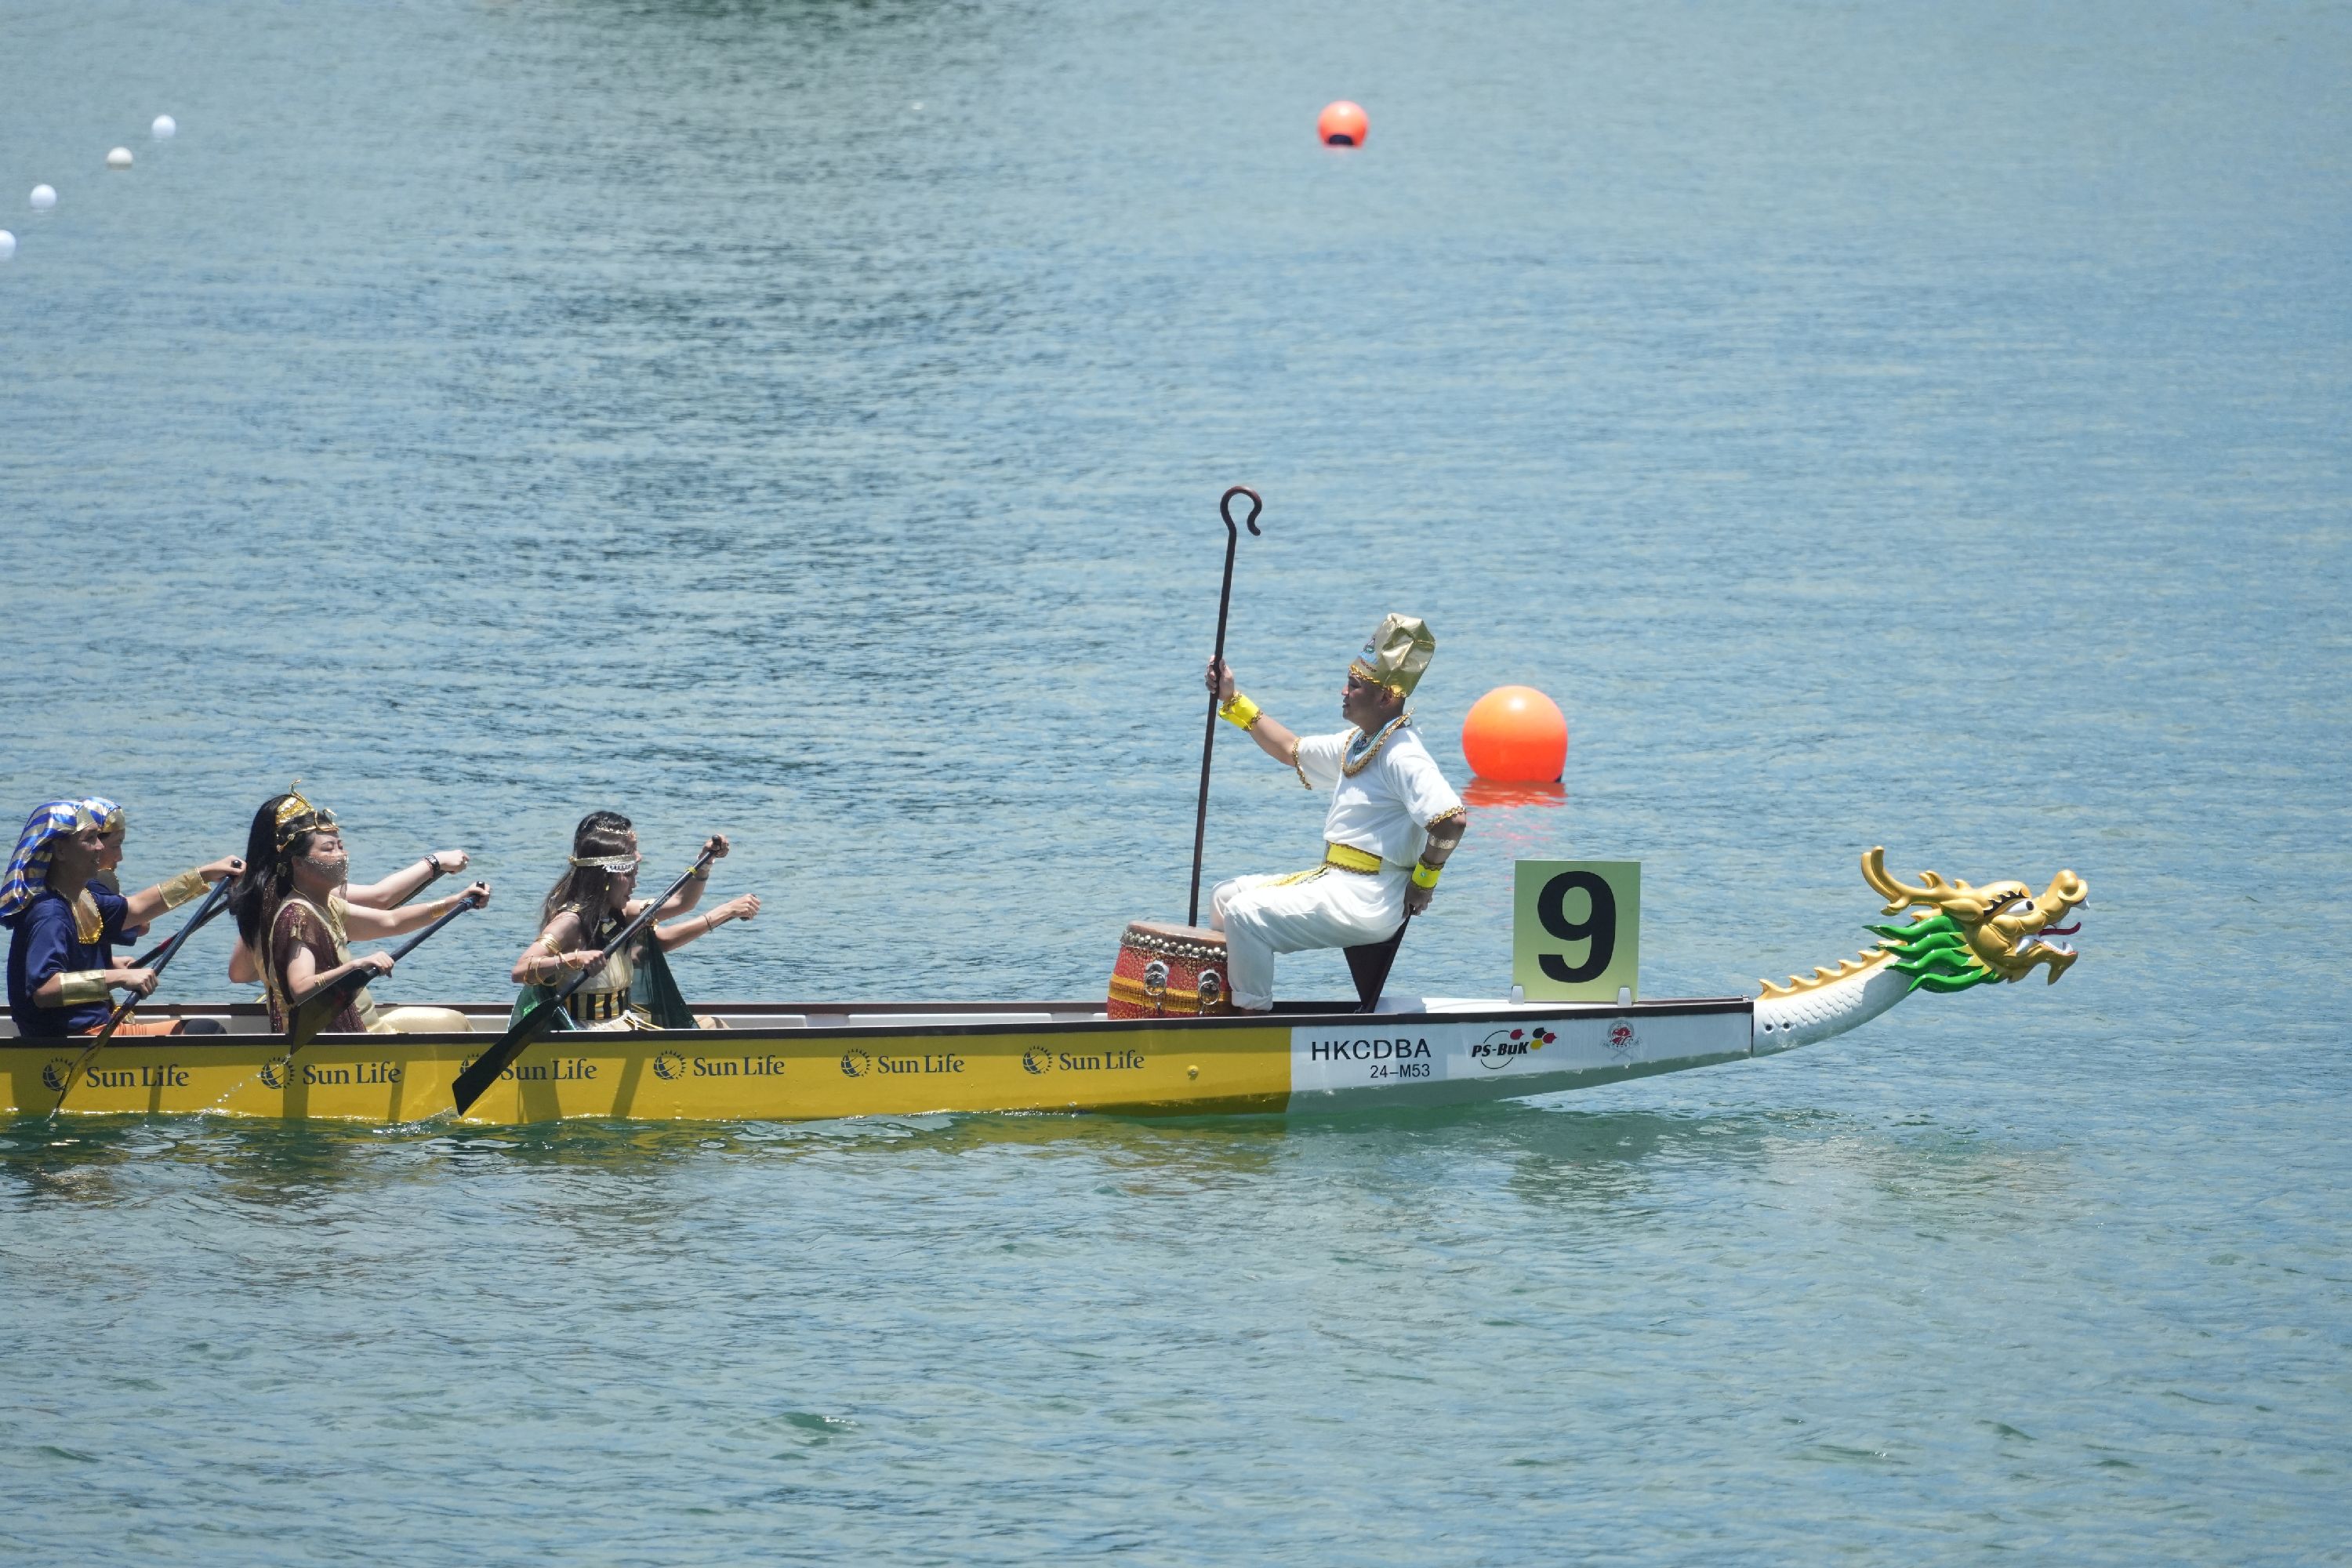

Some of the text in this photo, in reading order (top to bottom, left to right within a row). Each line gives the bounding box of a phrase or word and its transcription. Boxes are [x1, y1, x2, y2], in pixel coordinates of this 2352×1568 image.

[1537, 870, 1616, 983] 9
[1059, 1049, 1145, 1071] Sun Life
[1312, 1038, 1432, 1061] HKCDBA
[303, 1061, 401, 1085] Sun Life
[552, 1058, 597, 1080] Life
[693, 1054, 785, 1077] Sun Life
[877, 1053, 965, 1073] Sun Life
[1370, 1063, 1431, 1079] 24-M53
[86, 1064, 189, 1088] Sun Life
